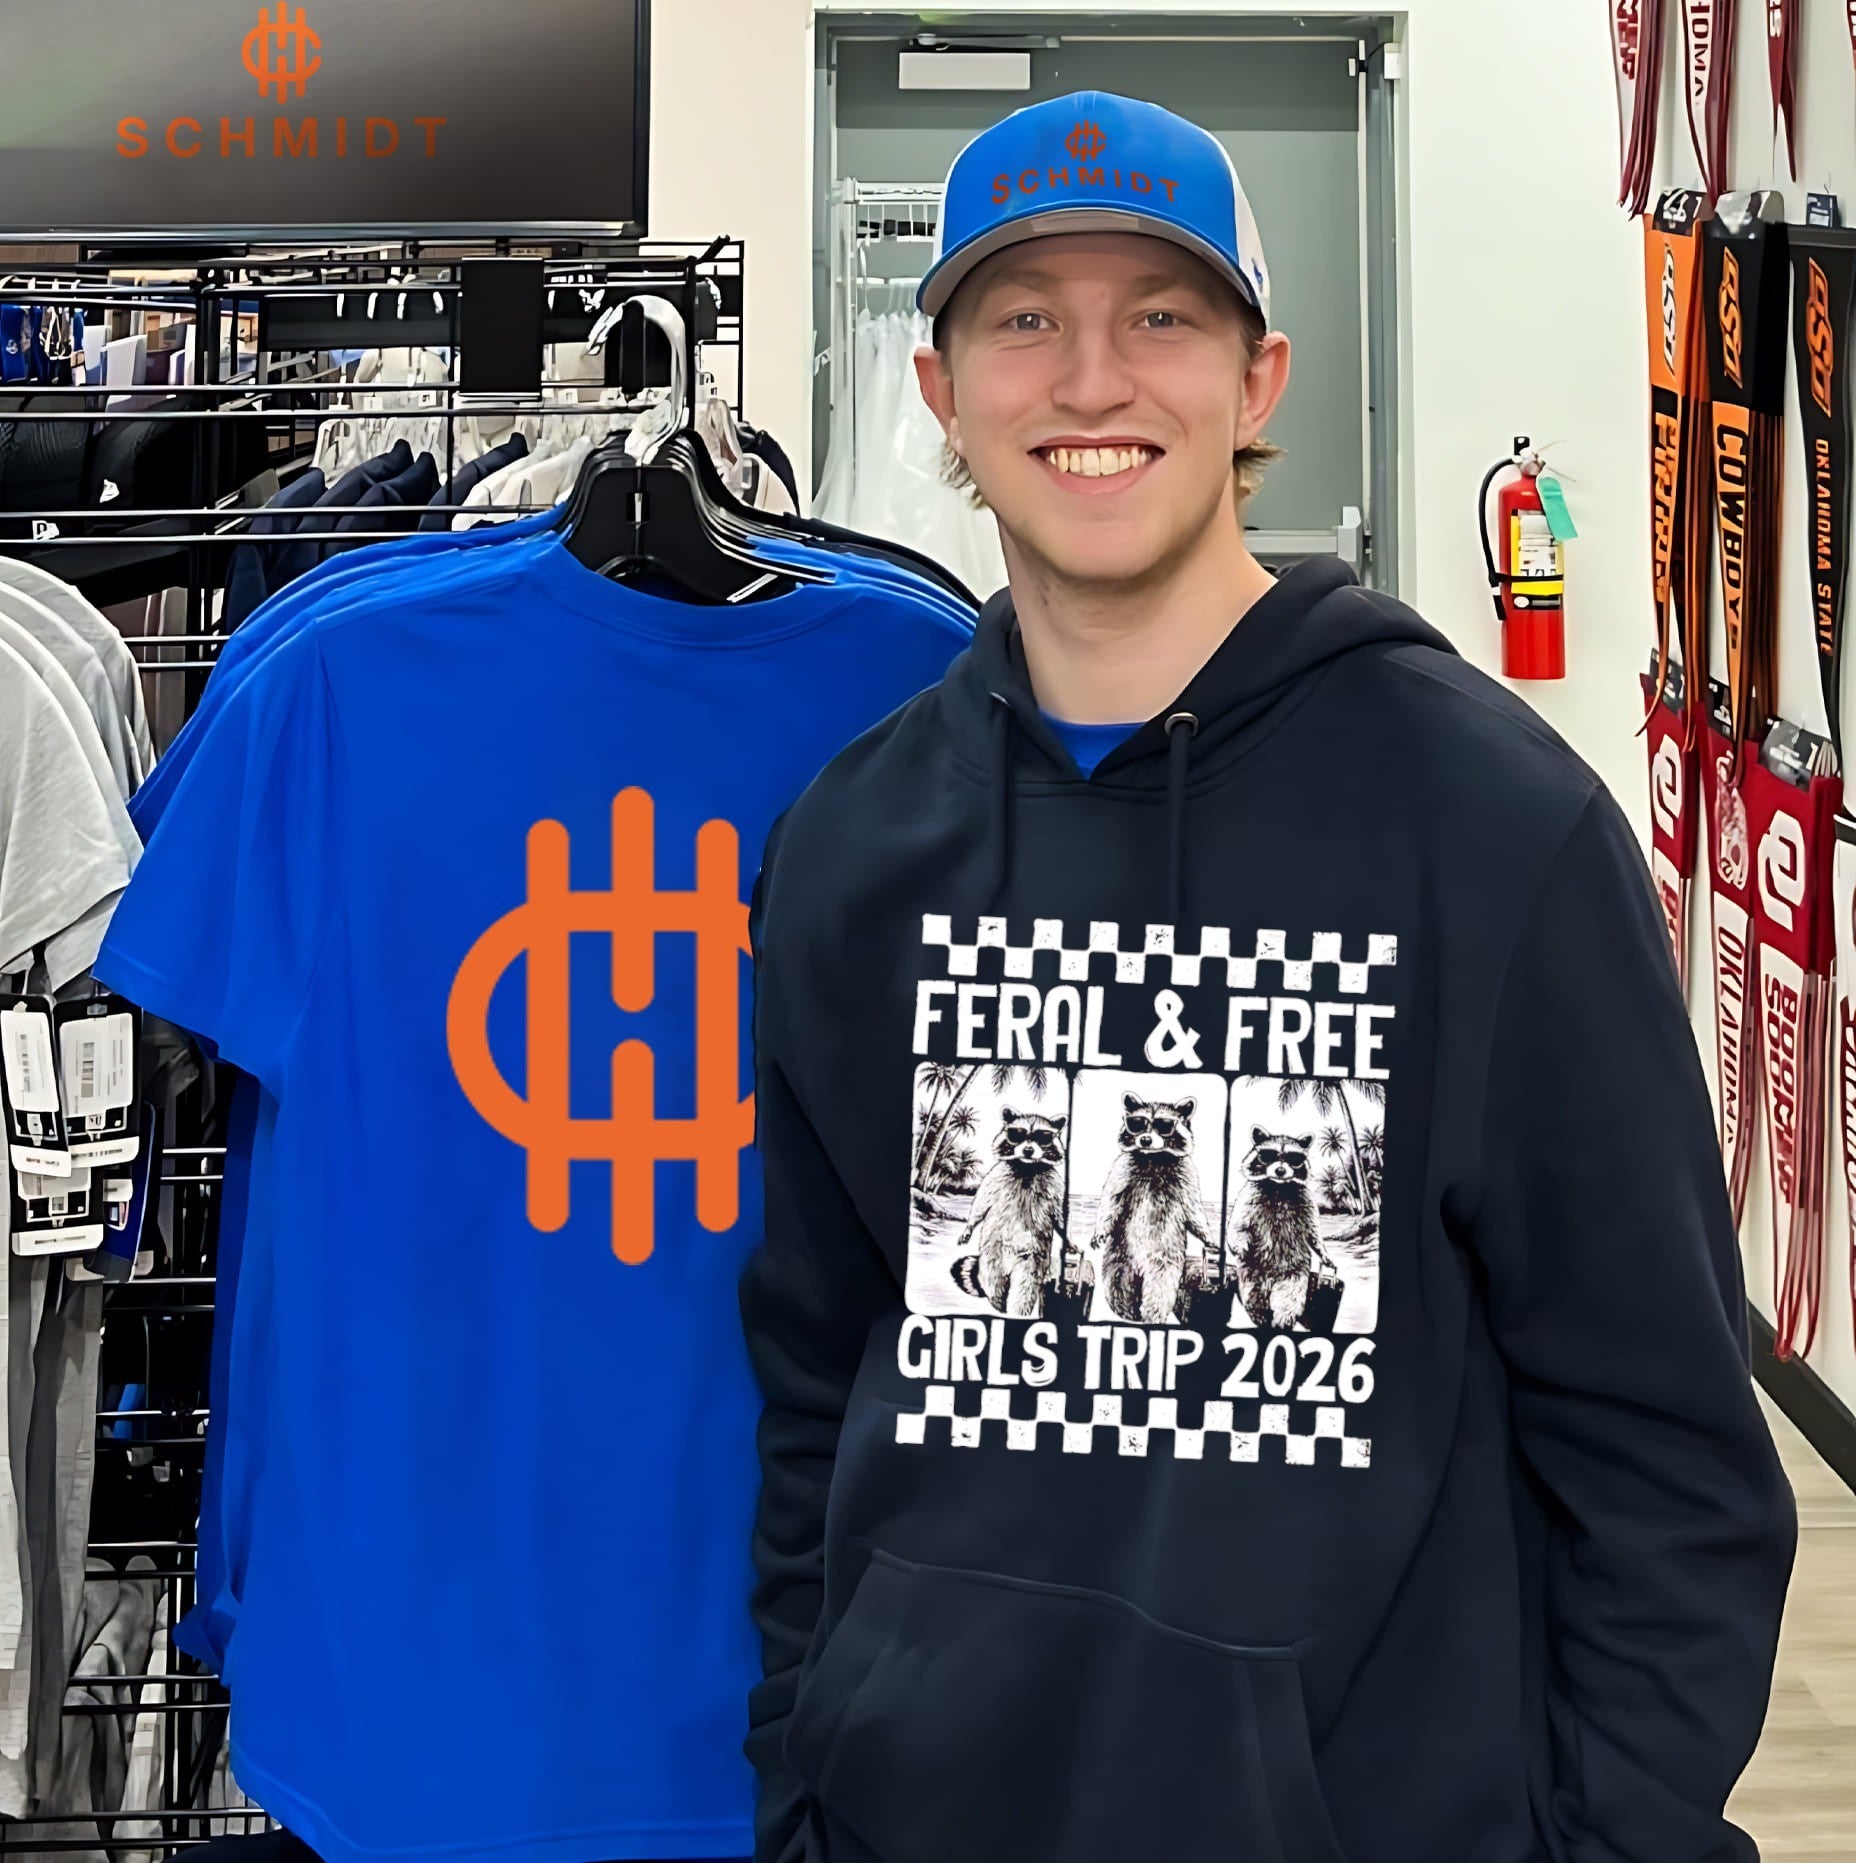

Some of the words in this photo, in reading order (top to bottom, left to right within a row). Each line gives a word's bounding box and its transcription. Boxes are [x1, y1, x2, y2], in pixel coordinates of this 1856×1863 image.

[115, 116, 448, 158] SCHMIDT
[991, 166, 1179, 205] SCHMIDT
[912, 980, 1122, 1066] FERAL
[1144, 989, 1203, 1069] &
[1224, 996, 1396, 1080] FREE
[897, 1314, 1059, 1387] GIRLS
[1077, 1325, 1205, 1392] TRIP
[1220, 1334, 1377, 1404] 2026
